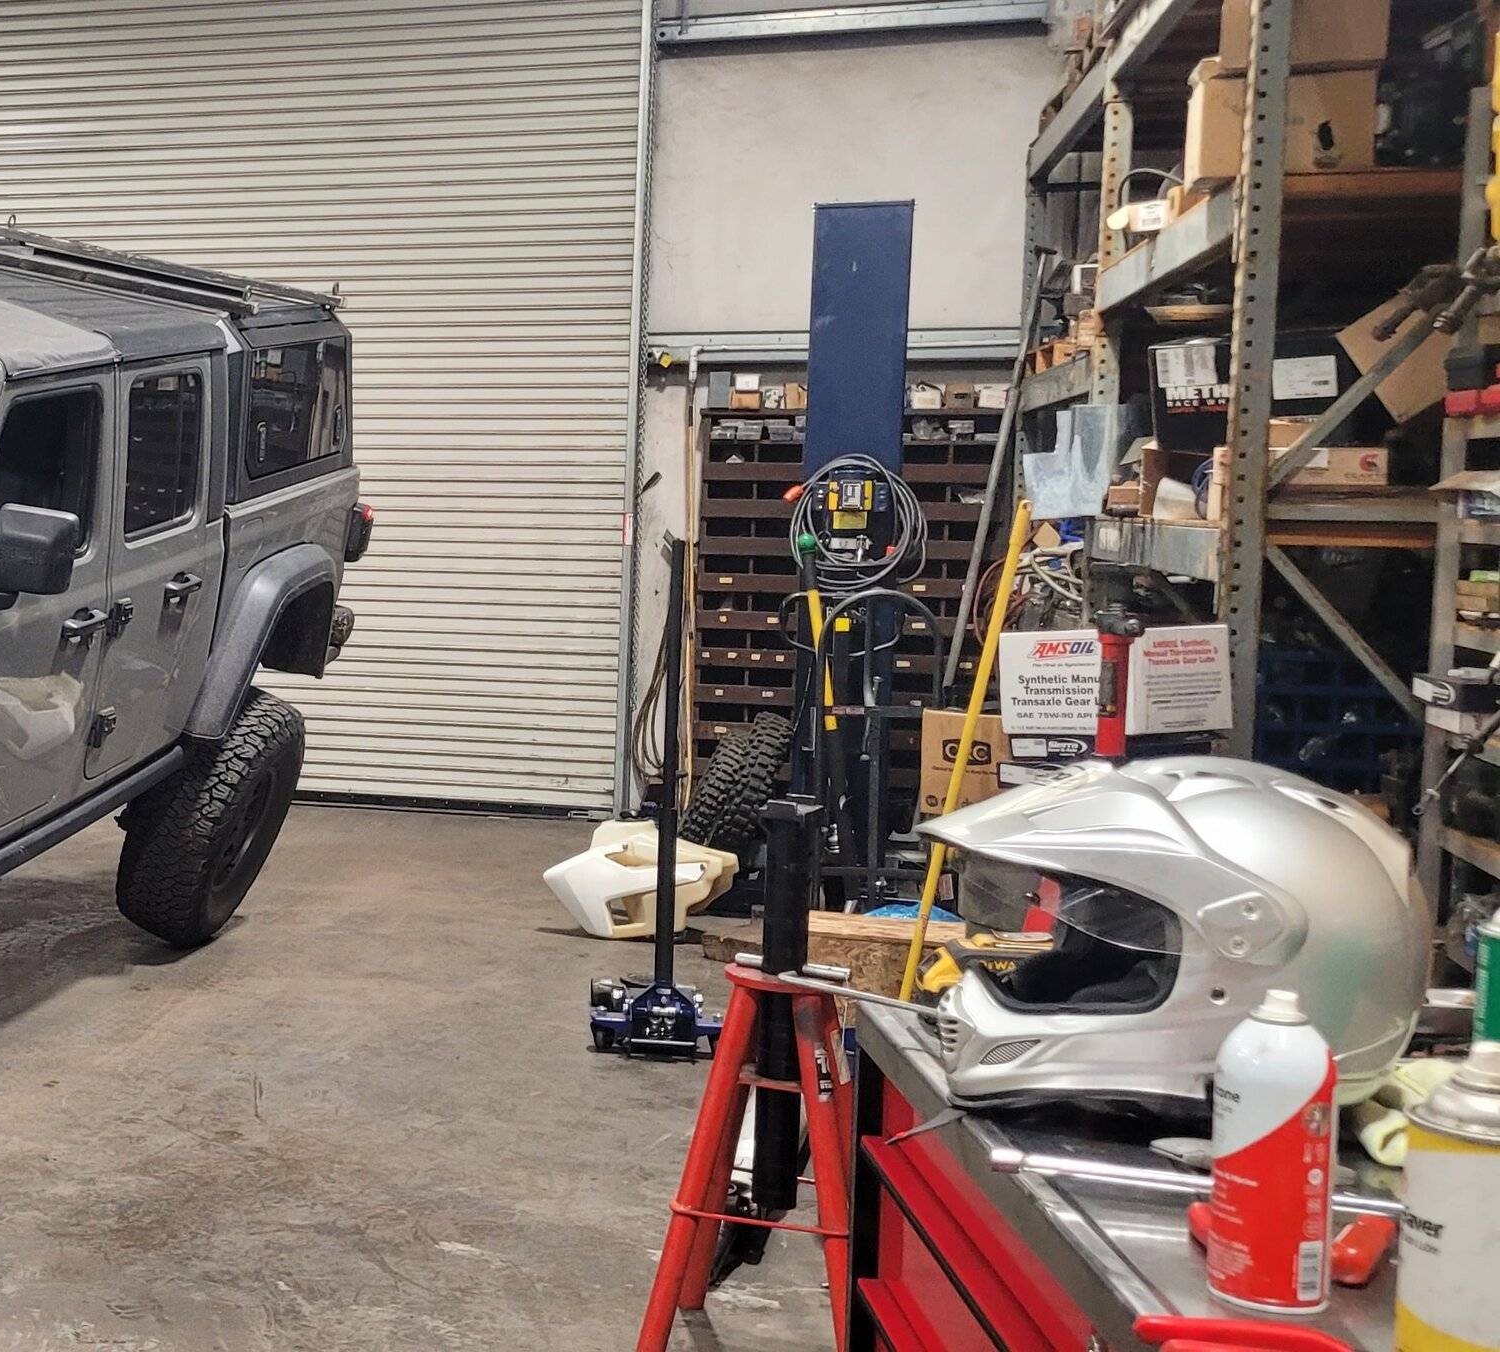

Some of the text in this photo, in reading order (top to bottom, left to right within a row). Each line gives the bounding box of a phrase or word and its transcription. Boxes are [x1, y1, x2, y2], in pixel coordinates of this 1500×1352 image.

[1031, 640, 1096, 659] AMSOIL
[1018, 674, 1068, 686] Synthetic
[1024, 685, 1094, 696] Transmission
[1011, 697, 1062, 706] Transaxle
[1065, 697, 1092, 707] Gear
[944, 743, 989, 762] CC
